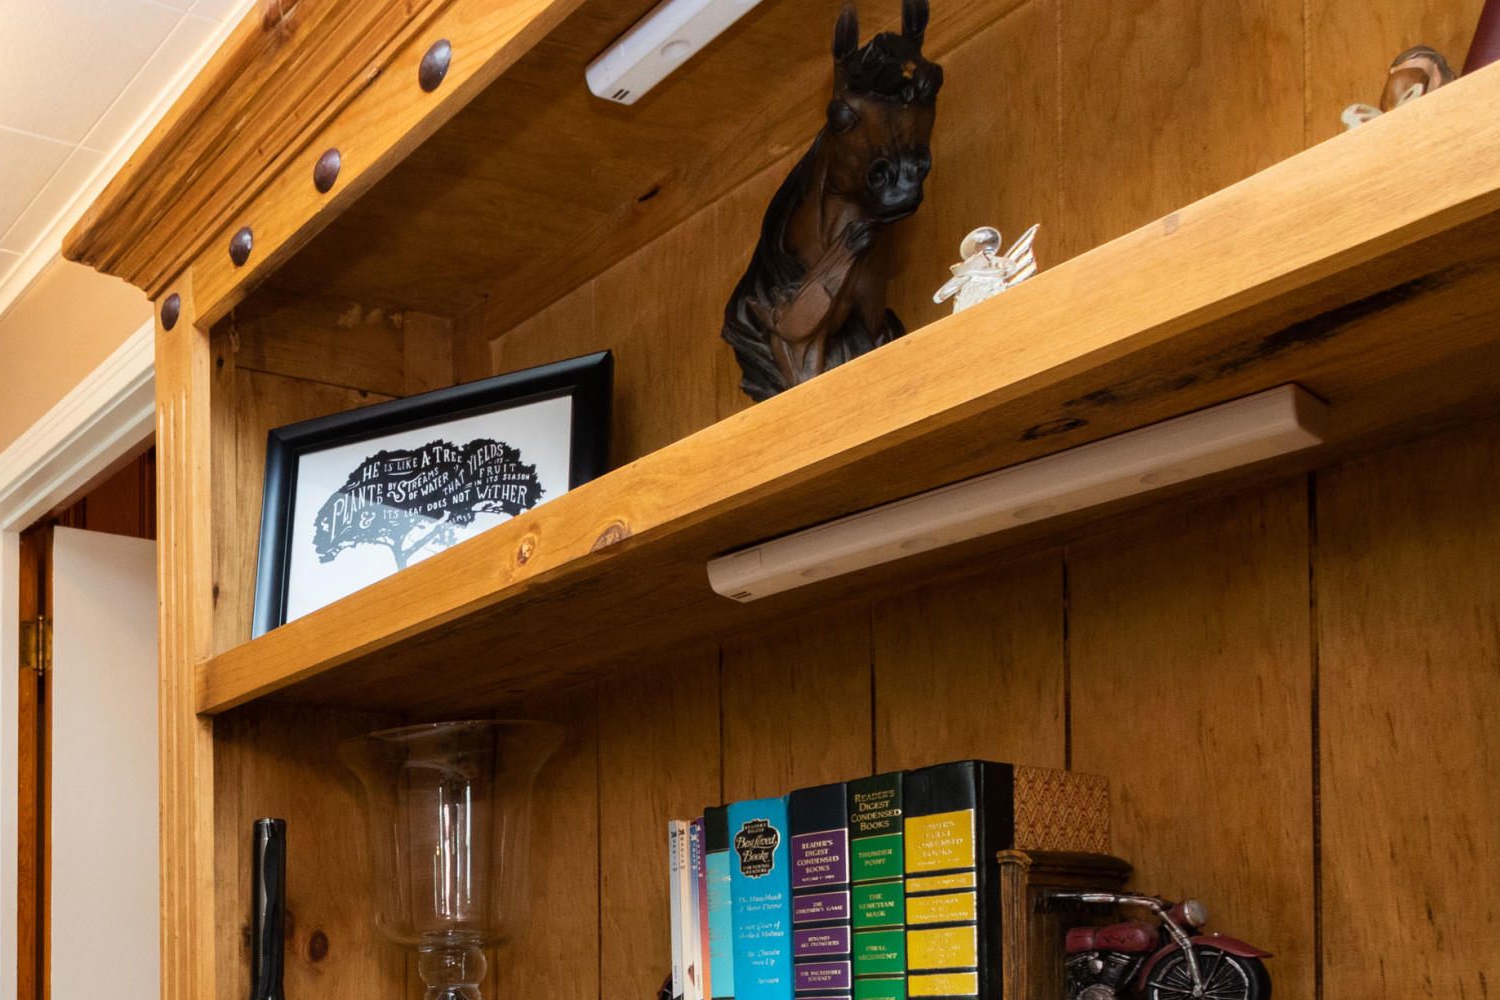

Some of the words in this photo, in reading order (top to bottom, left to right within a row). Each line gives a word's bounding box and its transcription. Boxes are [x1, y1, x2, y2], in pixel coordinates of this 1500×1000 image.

[363, 461, 380, 482] HE
[384, 463, 393, 472] IS
[397, 457, 418, 471] LIKE
[421, 451, 431, 469] A
[432, 446, 462, 463] TREE
[442, 469, 464, 496] THAT
[467, 444, 504, 475] YIELDS
[480, 464, 516, 478] FRUIT
[487, 475, 498, 483] ITS
[388, 482, 397, 490] BY
[409, 491, 419, 500] OF
[420, 472, 449, 496] WATER
[359, 511, 376, 529] &
[383, 509, 399, 520] ITS
[404, 506, 422, 518] LEAF
[427, 498, 447, 512] DOES
[452, 489, 471, 505] NOT
[859, 800, 890, 812] DIGEST
[851, 808, 902, 823] CONDENSED
[860, 820, 890, 832] BOOKS
[805, 849, 828, 857] DIGEST
[858, 848, 893, 859] THUNDER
[796, 855, 839, 867] CONDENSED
[805, 865, 830, 874] BOOKS
[858, 901, 895, 910] VENETIAN
[866, 910, 886, 918] MASK
